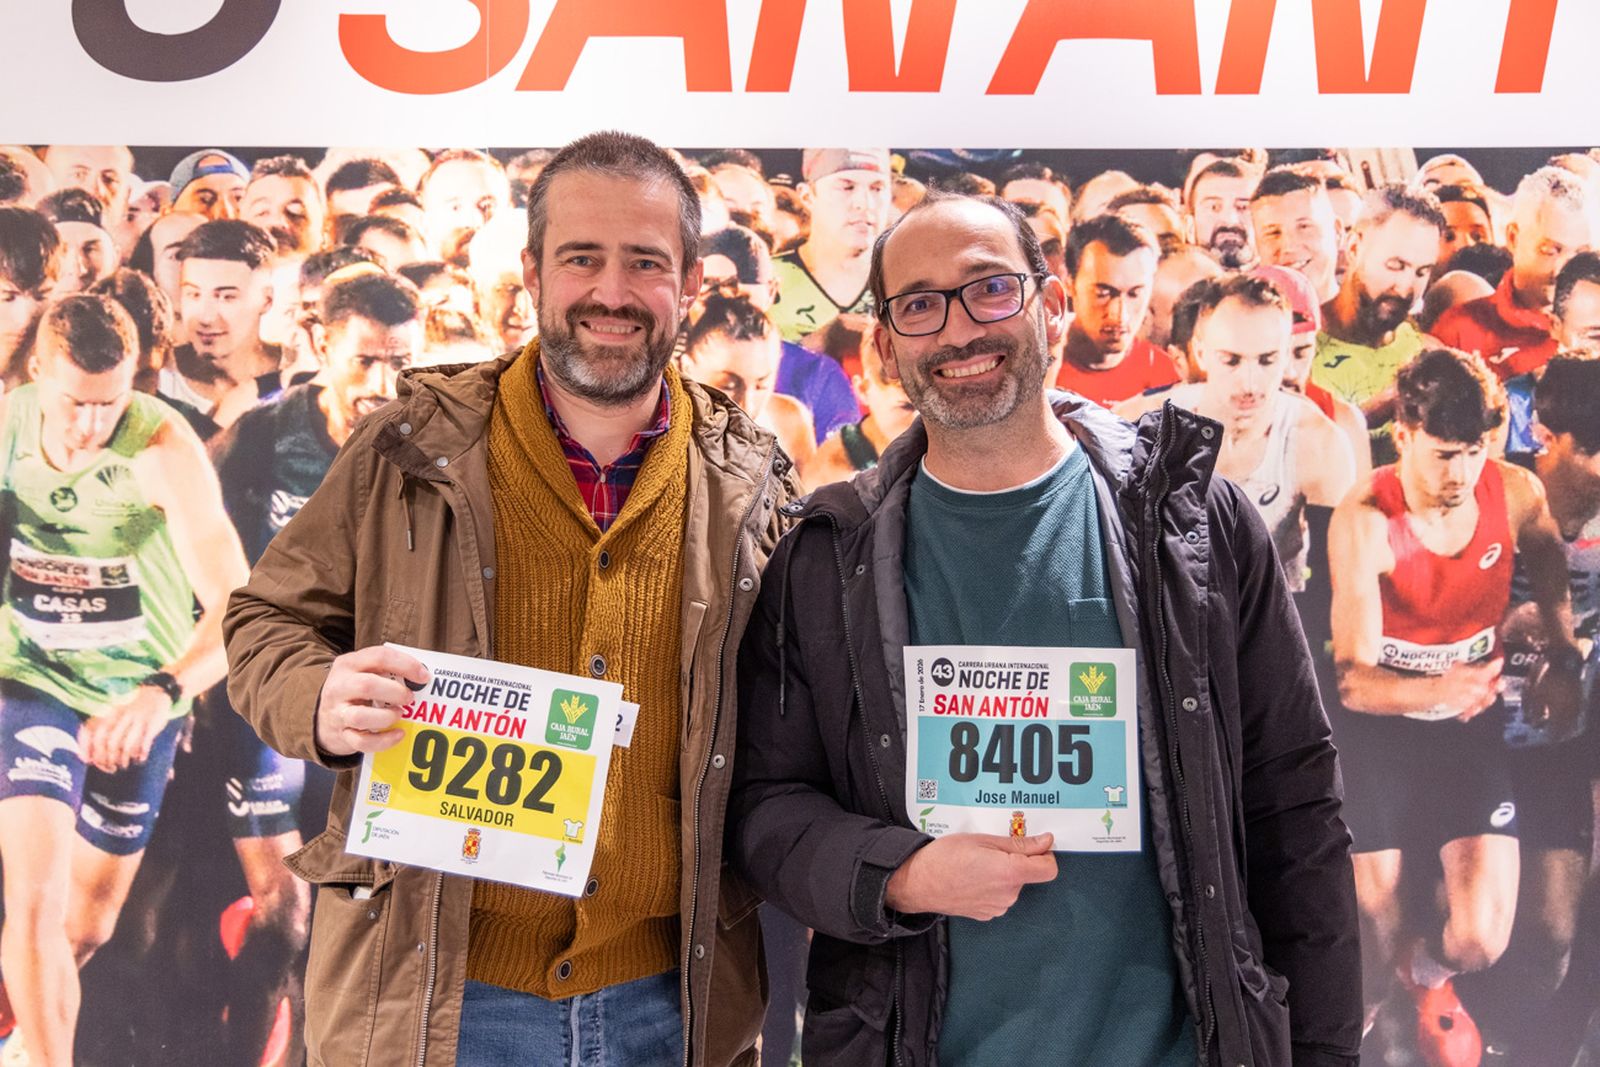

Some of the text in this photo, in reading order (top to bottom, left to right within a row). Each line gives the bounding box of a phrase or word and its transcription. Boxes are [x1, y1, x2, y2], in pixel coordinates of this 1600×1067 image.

[33, 594, 107, 612] CASAS
[932, 664, 954, 679] 43
[1007, 662, 1049, 670] INTERNACIONAL
[434, 668, 532, 691] CARRERA URBANA INTERNACIONAL
[918, 676, 924, 685] de
[959, 670, 1050, 690] NOCHE DE
[430, 677, 532, 712] NOCHE DE
[933, 691, 1049, 718] SAN ANTÓN
[919, 704, 925, 712] 17
[448, 707, 527, 739] ANTÓN
[948, 721, 1093, 785] 8405
[408, 729, 563, 814] 9282
[975, 790, 1060, 804] Jose Manuel
[439, 801, 515, 827] SALVADOR
